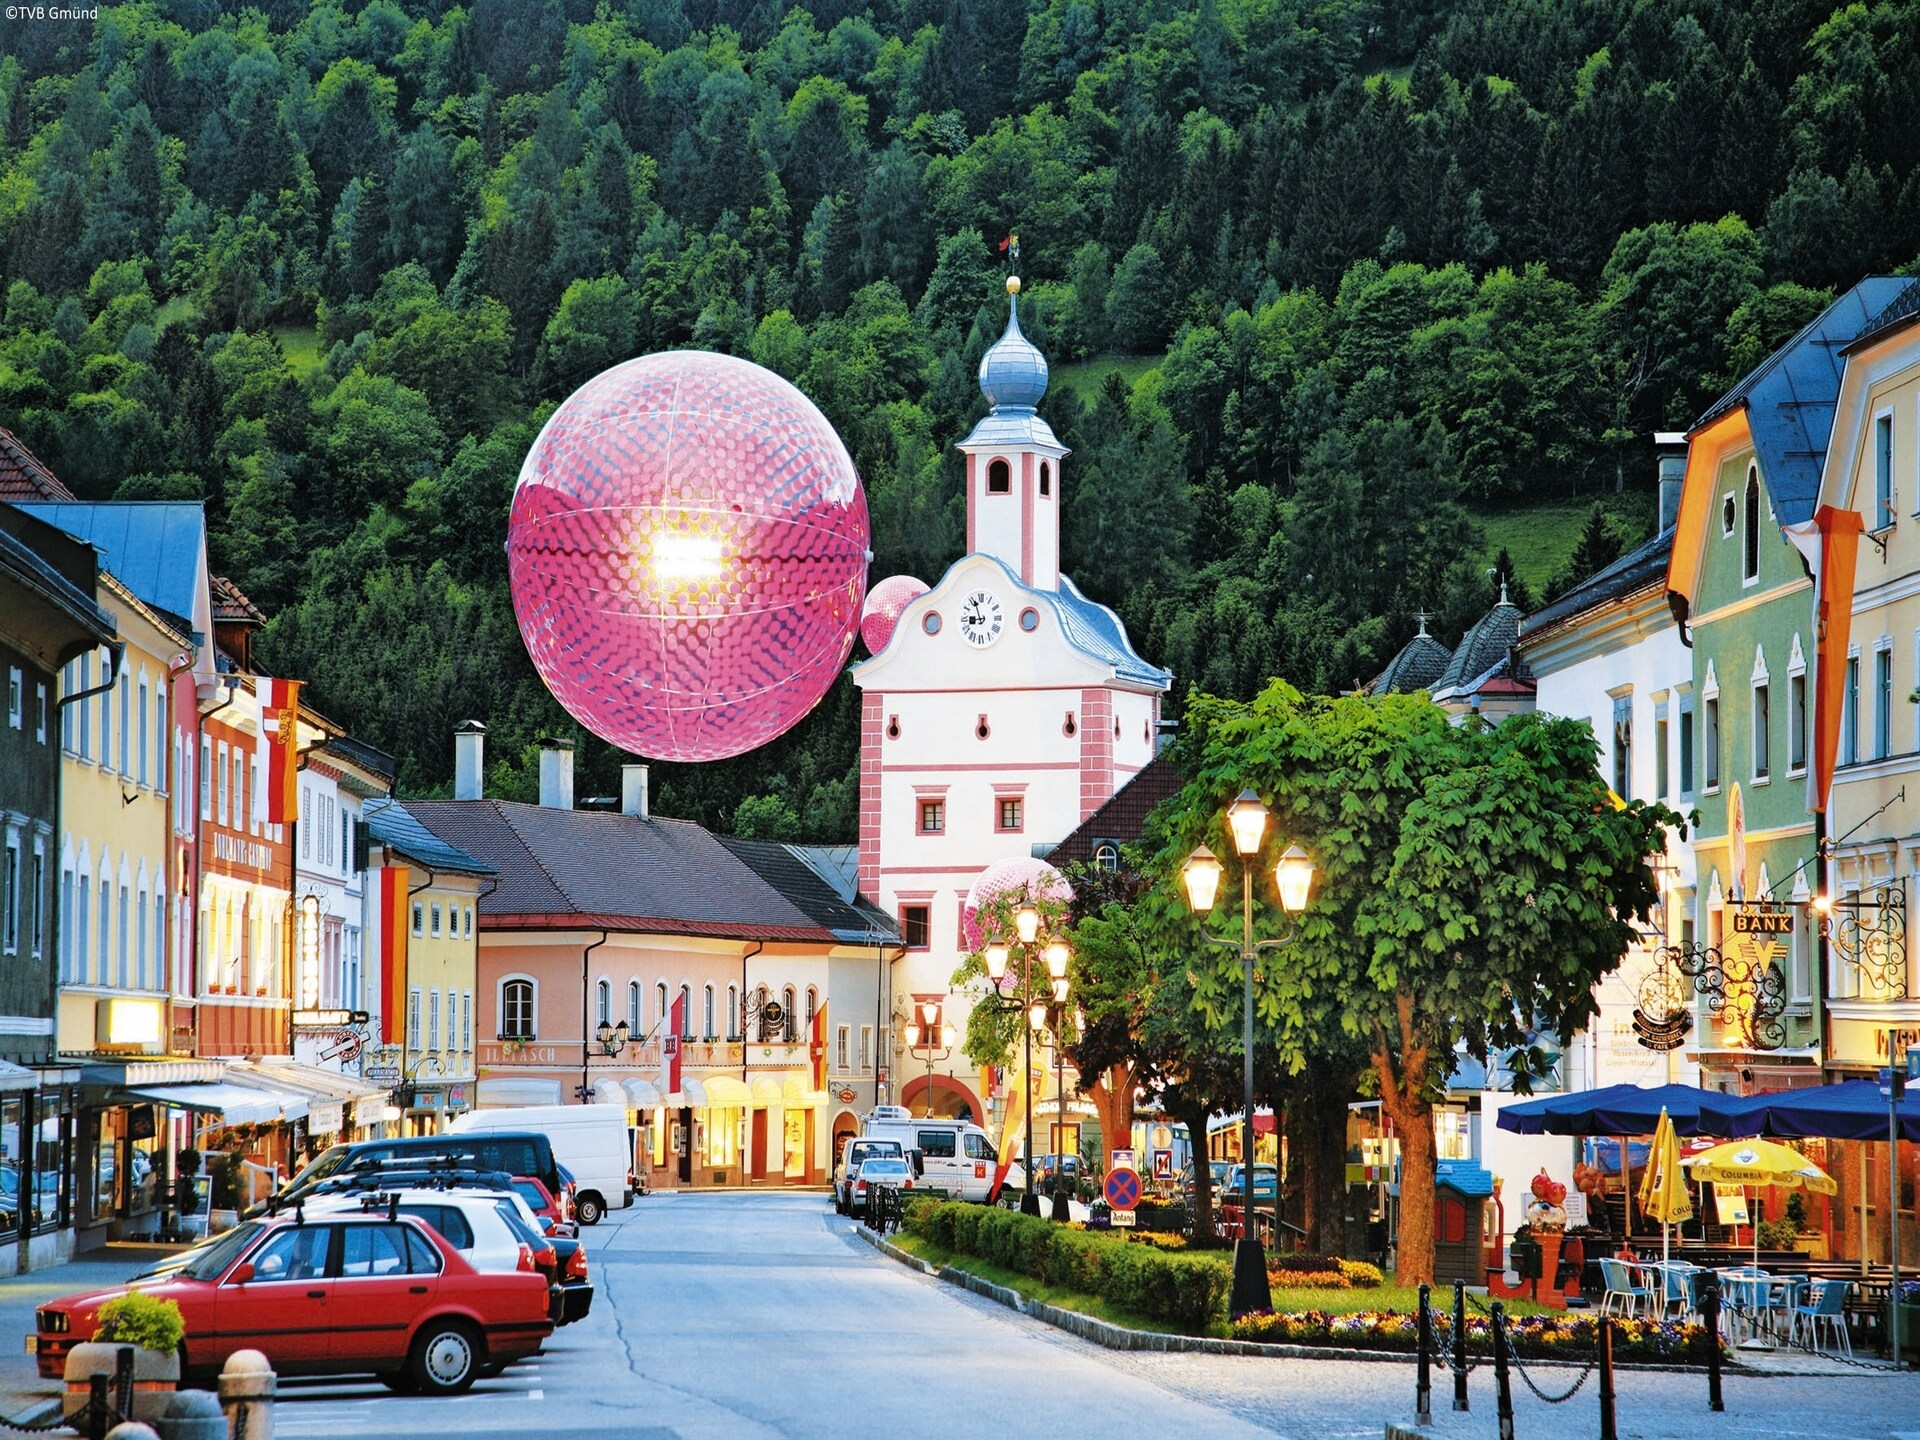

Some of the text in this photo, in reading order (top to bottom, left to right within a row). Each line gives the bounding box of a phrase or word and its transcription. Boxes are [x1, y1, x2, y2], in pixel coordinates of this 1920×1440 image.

[1737, 917, 1790, 931] BANK
[1721, 1169, 1762, 1180] COLUMBIA
[1112, 1211, 1134, 1225] Anfang
